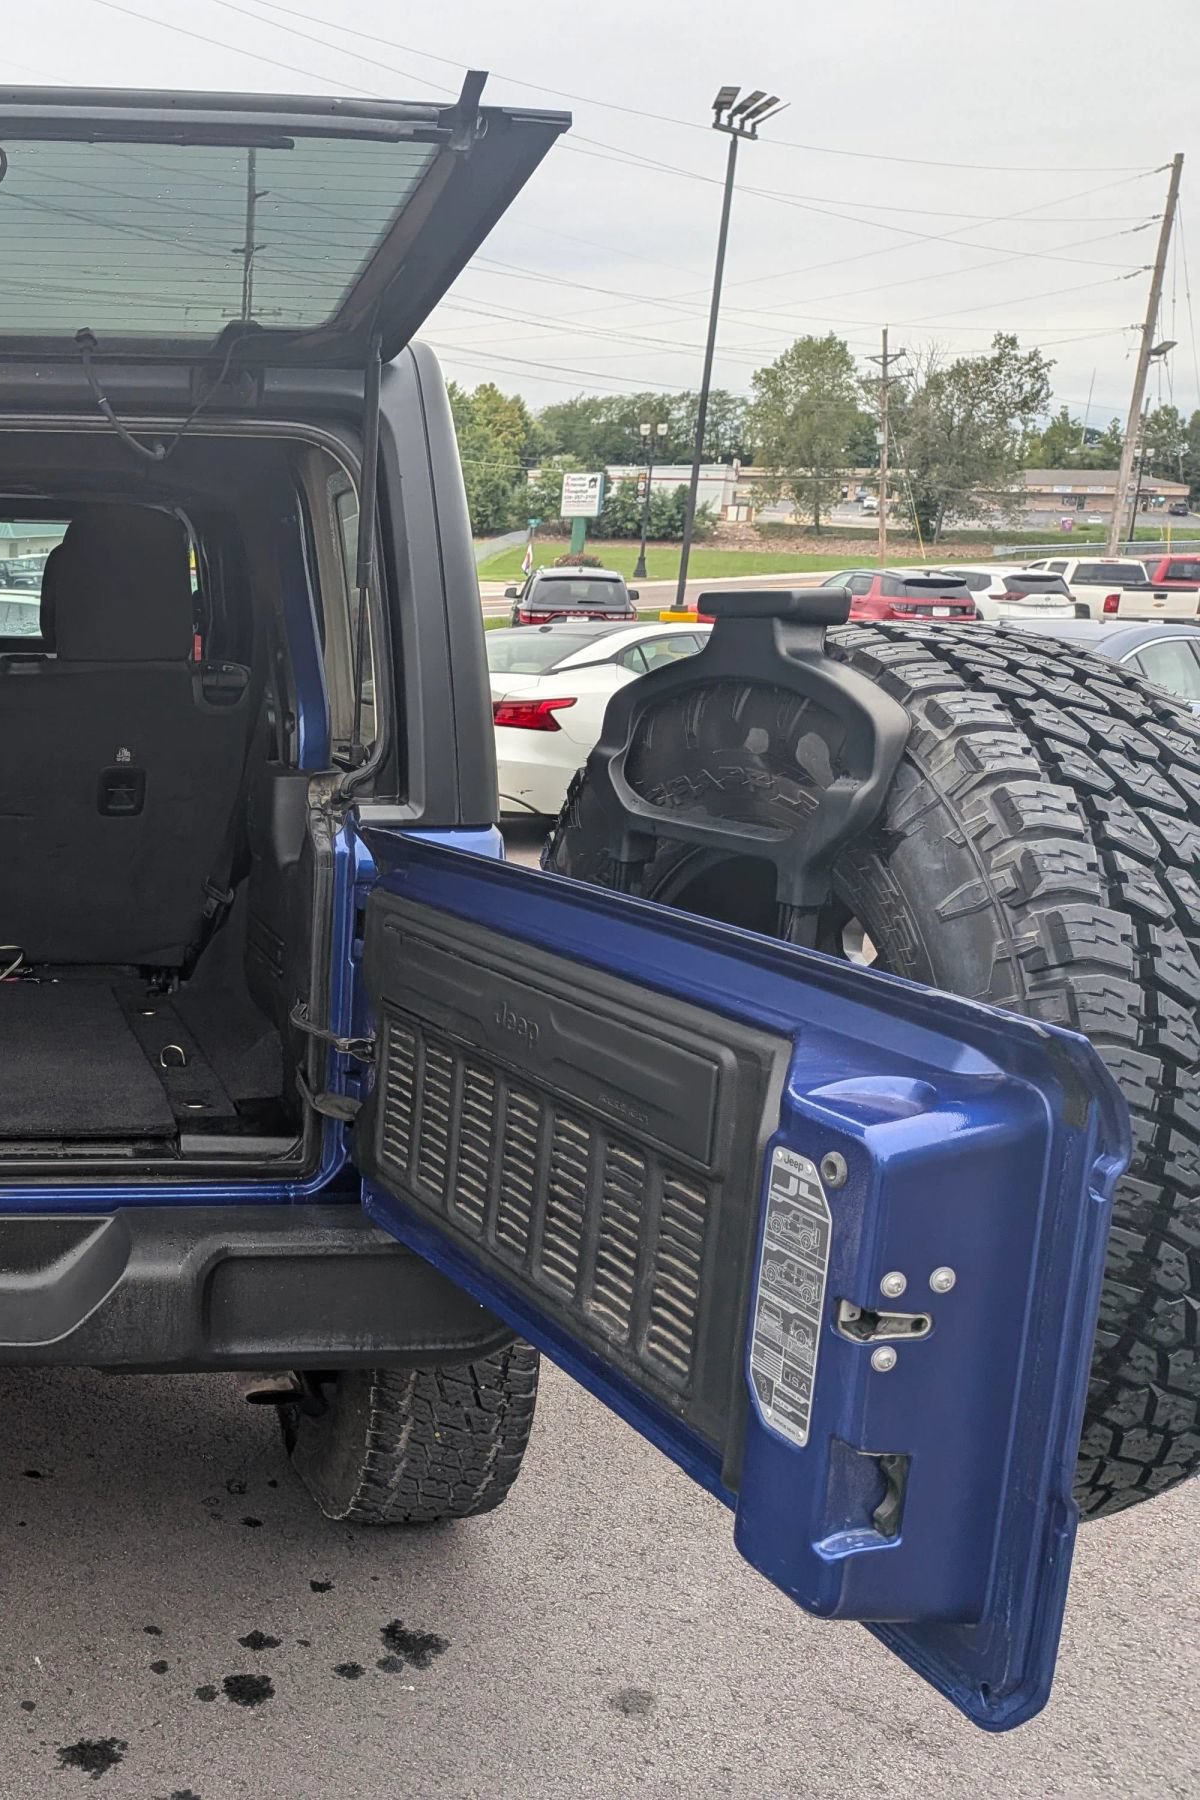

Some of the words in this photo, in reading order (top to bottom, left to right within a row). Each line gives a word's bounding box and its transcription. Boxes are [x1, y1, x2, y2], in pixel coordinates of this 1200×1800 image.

[494, 1001, 539, 1049] Jeep
[783, 1154, 804, 1172] Jeep
[772, 1175, 824, 1207] JL
[783, 1368, 810, 1396] USA
